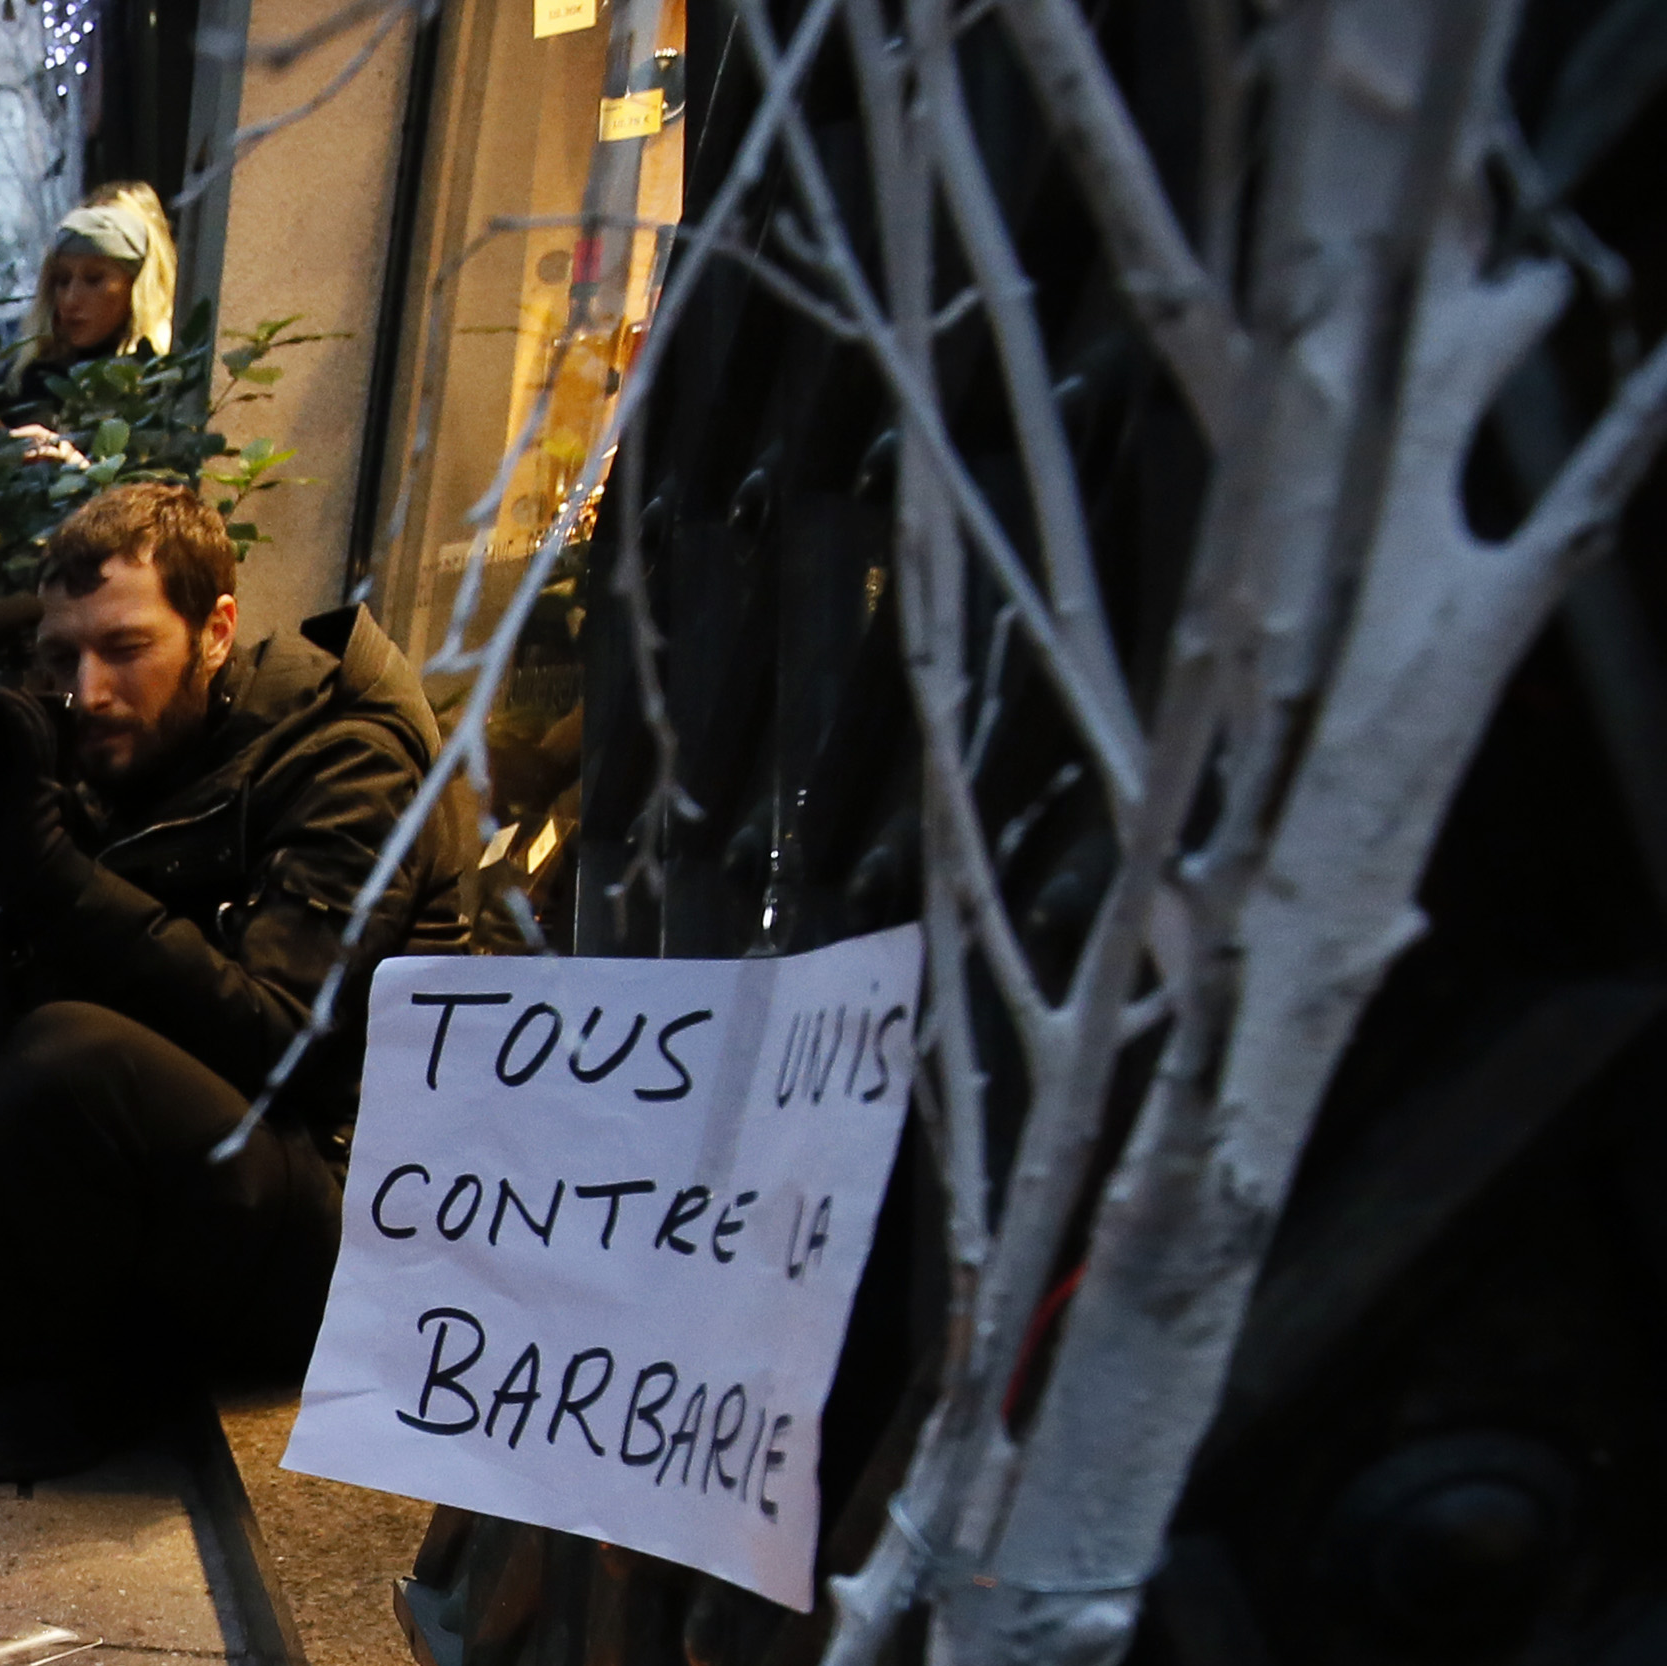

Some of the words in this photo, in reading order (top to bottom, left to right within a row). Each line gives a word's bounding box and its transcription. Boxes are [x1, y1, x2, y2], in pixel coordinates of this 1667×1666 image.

[411, 993, 713, 1102] TOUS
[775, 981, 913, 1109] UNIS
[372, 1164, 758, 1264] CONTRE
[785, 1194, 833, 1281] LA
[396, 1307, 793, 1524] BARBARIE
